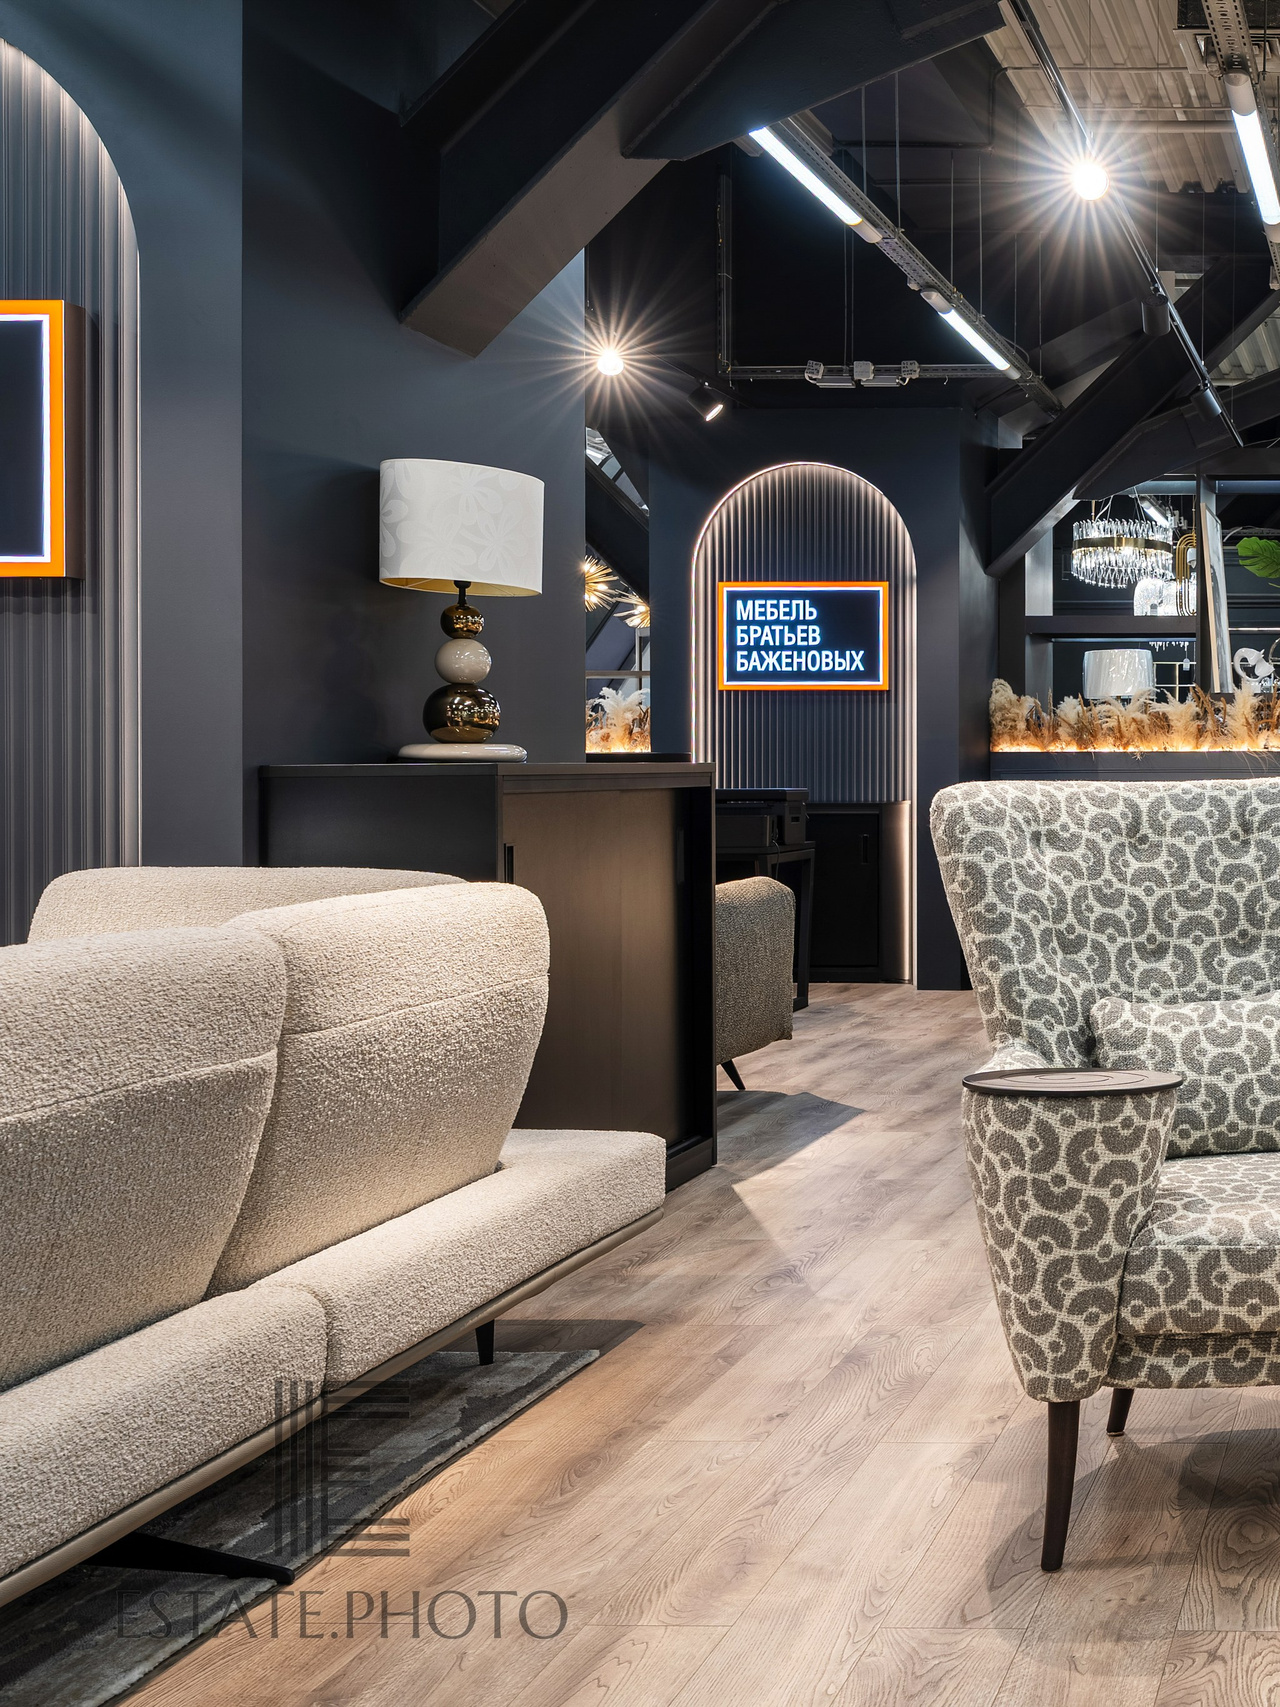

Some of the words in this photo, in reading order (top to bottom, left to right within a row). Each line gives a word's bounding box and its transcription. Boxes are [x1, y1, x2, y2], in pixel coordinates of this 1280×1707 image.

[736, 600, 818, 620] МЕБЕЛЬ
[736, 625, 821, 646] БРАТЬЕВ
[736, 650, 865, 671] БАЖЕНОВЫХ
